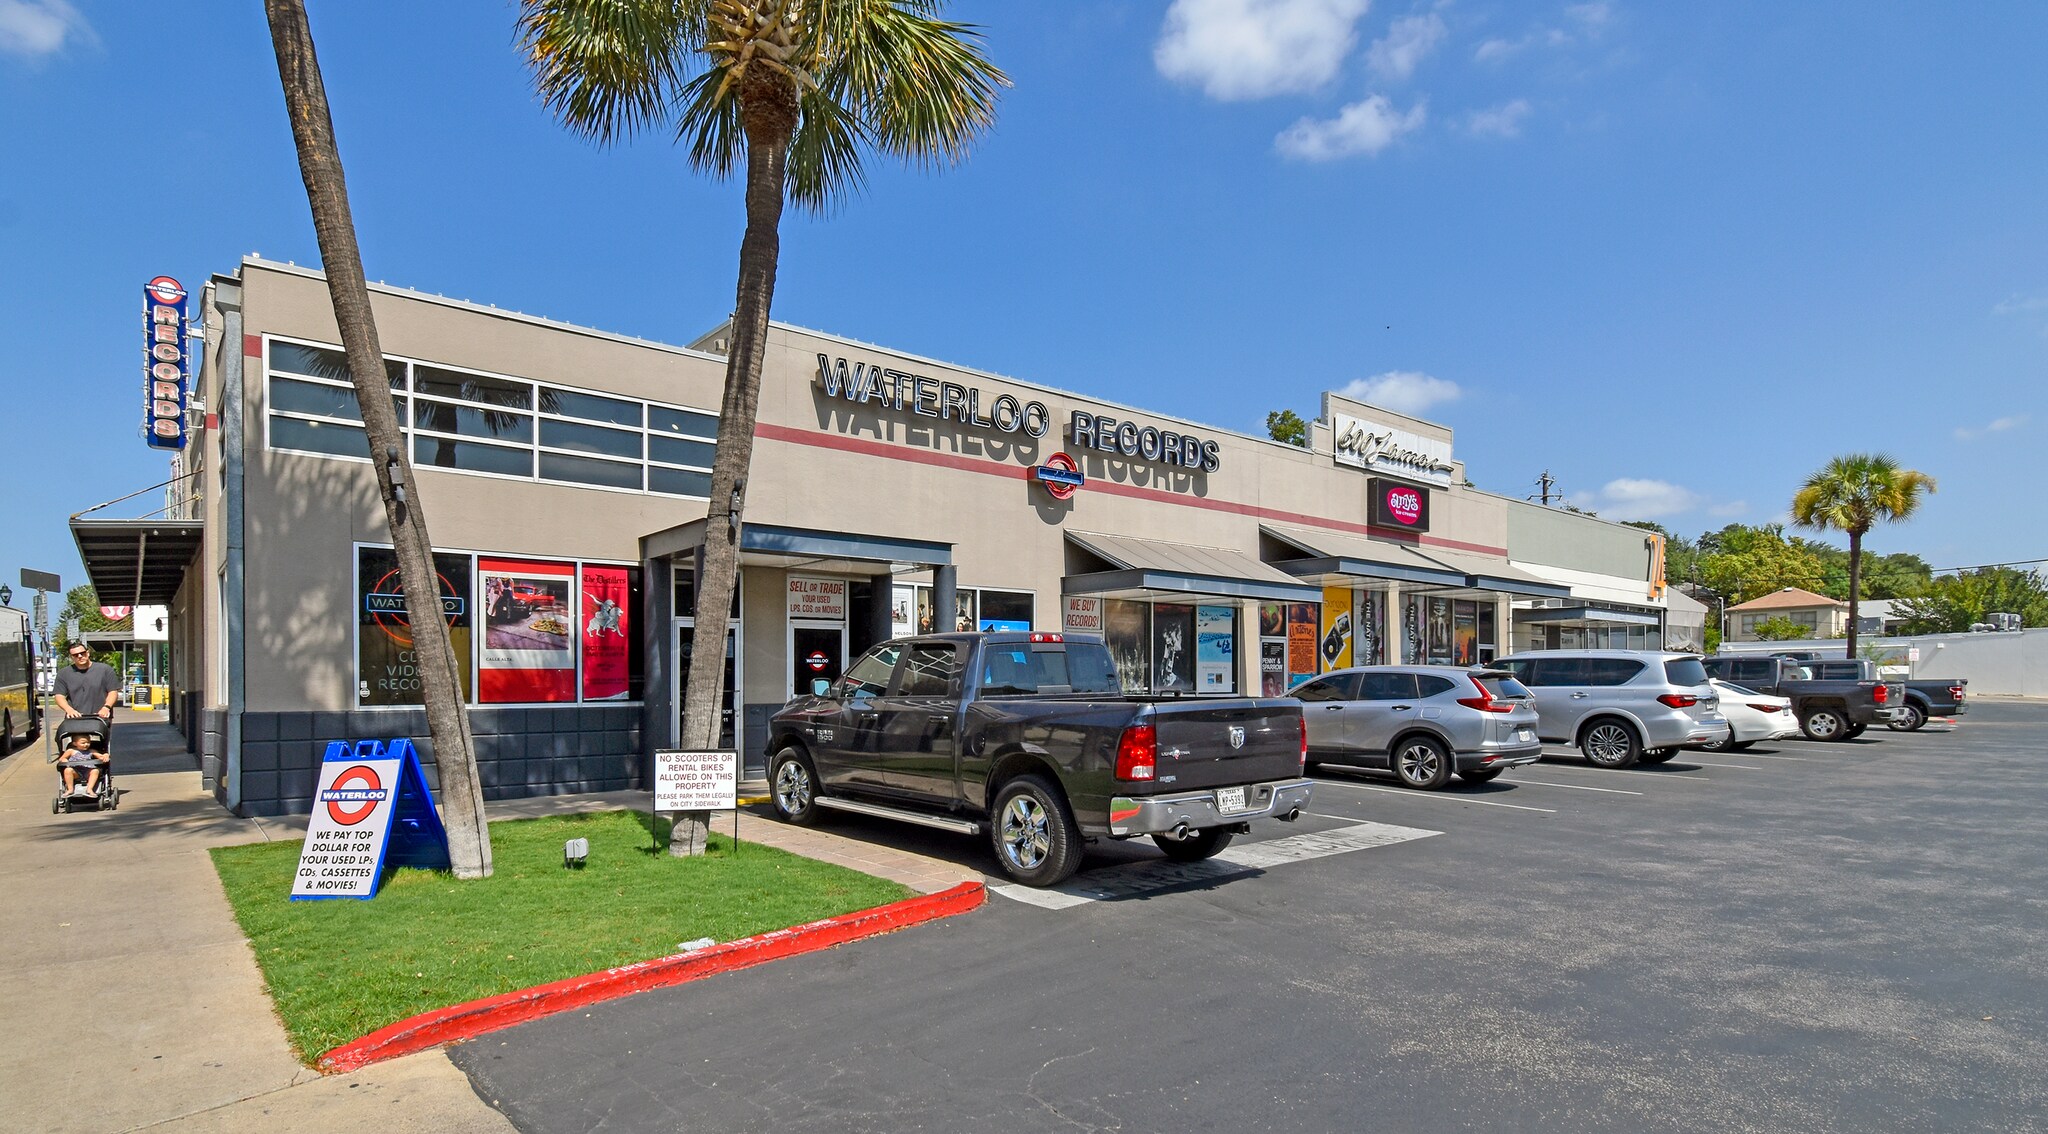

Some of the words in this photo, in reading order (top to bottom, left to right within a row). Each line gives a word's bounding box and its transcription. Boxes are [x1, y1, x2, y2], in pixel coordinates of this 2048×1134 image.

[145, 285, 187, 296] WATERLOO
[153, 304, 180, 439] RECORDS
[816, 352, 1050, 439] WATERLOO
[1070, 409, 1221, 475] RECORDS
[1337, 421, 1374, 455] 600
[1365, 432, 1454, 472] Lamar
[1647, 534, 1666, 598] 24
[583, 574, 595, 584] The
[596, 574, 626, 584] Distillers
[790, 581, 808, 593] SELL
[810, 583, 817, 591] OR
[820, 583, 843, 595] TRADE
[802, 594, 816, 603] YOUR
[816, 595, 831, 604] USED
[822, 605, 842, 614] MOVIES
[1070, 598, 1081, 611] WE
[1082, 599, 1096, 612] BUY
[1066, 615, 1100, 628] RECORDS!
[675, 754, 718, 762] SCOOTERS
[721, 754, 733, 762] OR
[675, 782, 716, 790] PROPERTY
[323, 791, 386, 800] WATERLOO
[316, 831, 331, 840] WE
[333, 831, 351, 840] PAY
[355, 831, 374, 839] TOP
[312, 843, 349, 852] DOLLAR
[352, 843, 371, 852] FOR
[302, 855, 328, 864] YOUR
[331, 855, 356, 864] USED
[359, 856, 375, 865] LPs,
[299, 868, 318, 877] CDs,
[321, 868, 371, 877] CASSETTES
[305, 881, 313, 889] &
[316, 881, 357, 889] MOVIES!
